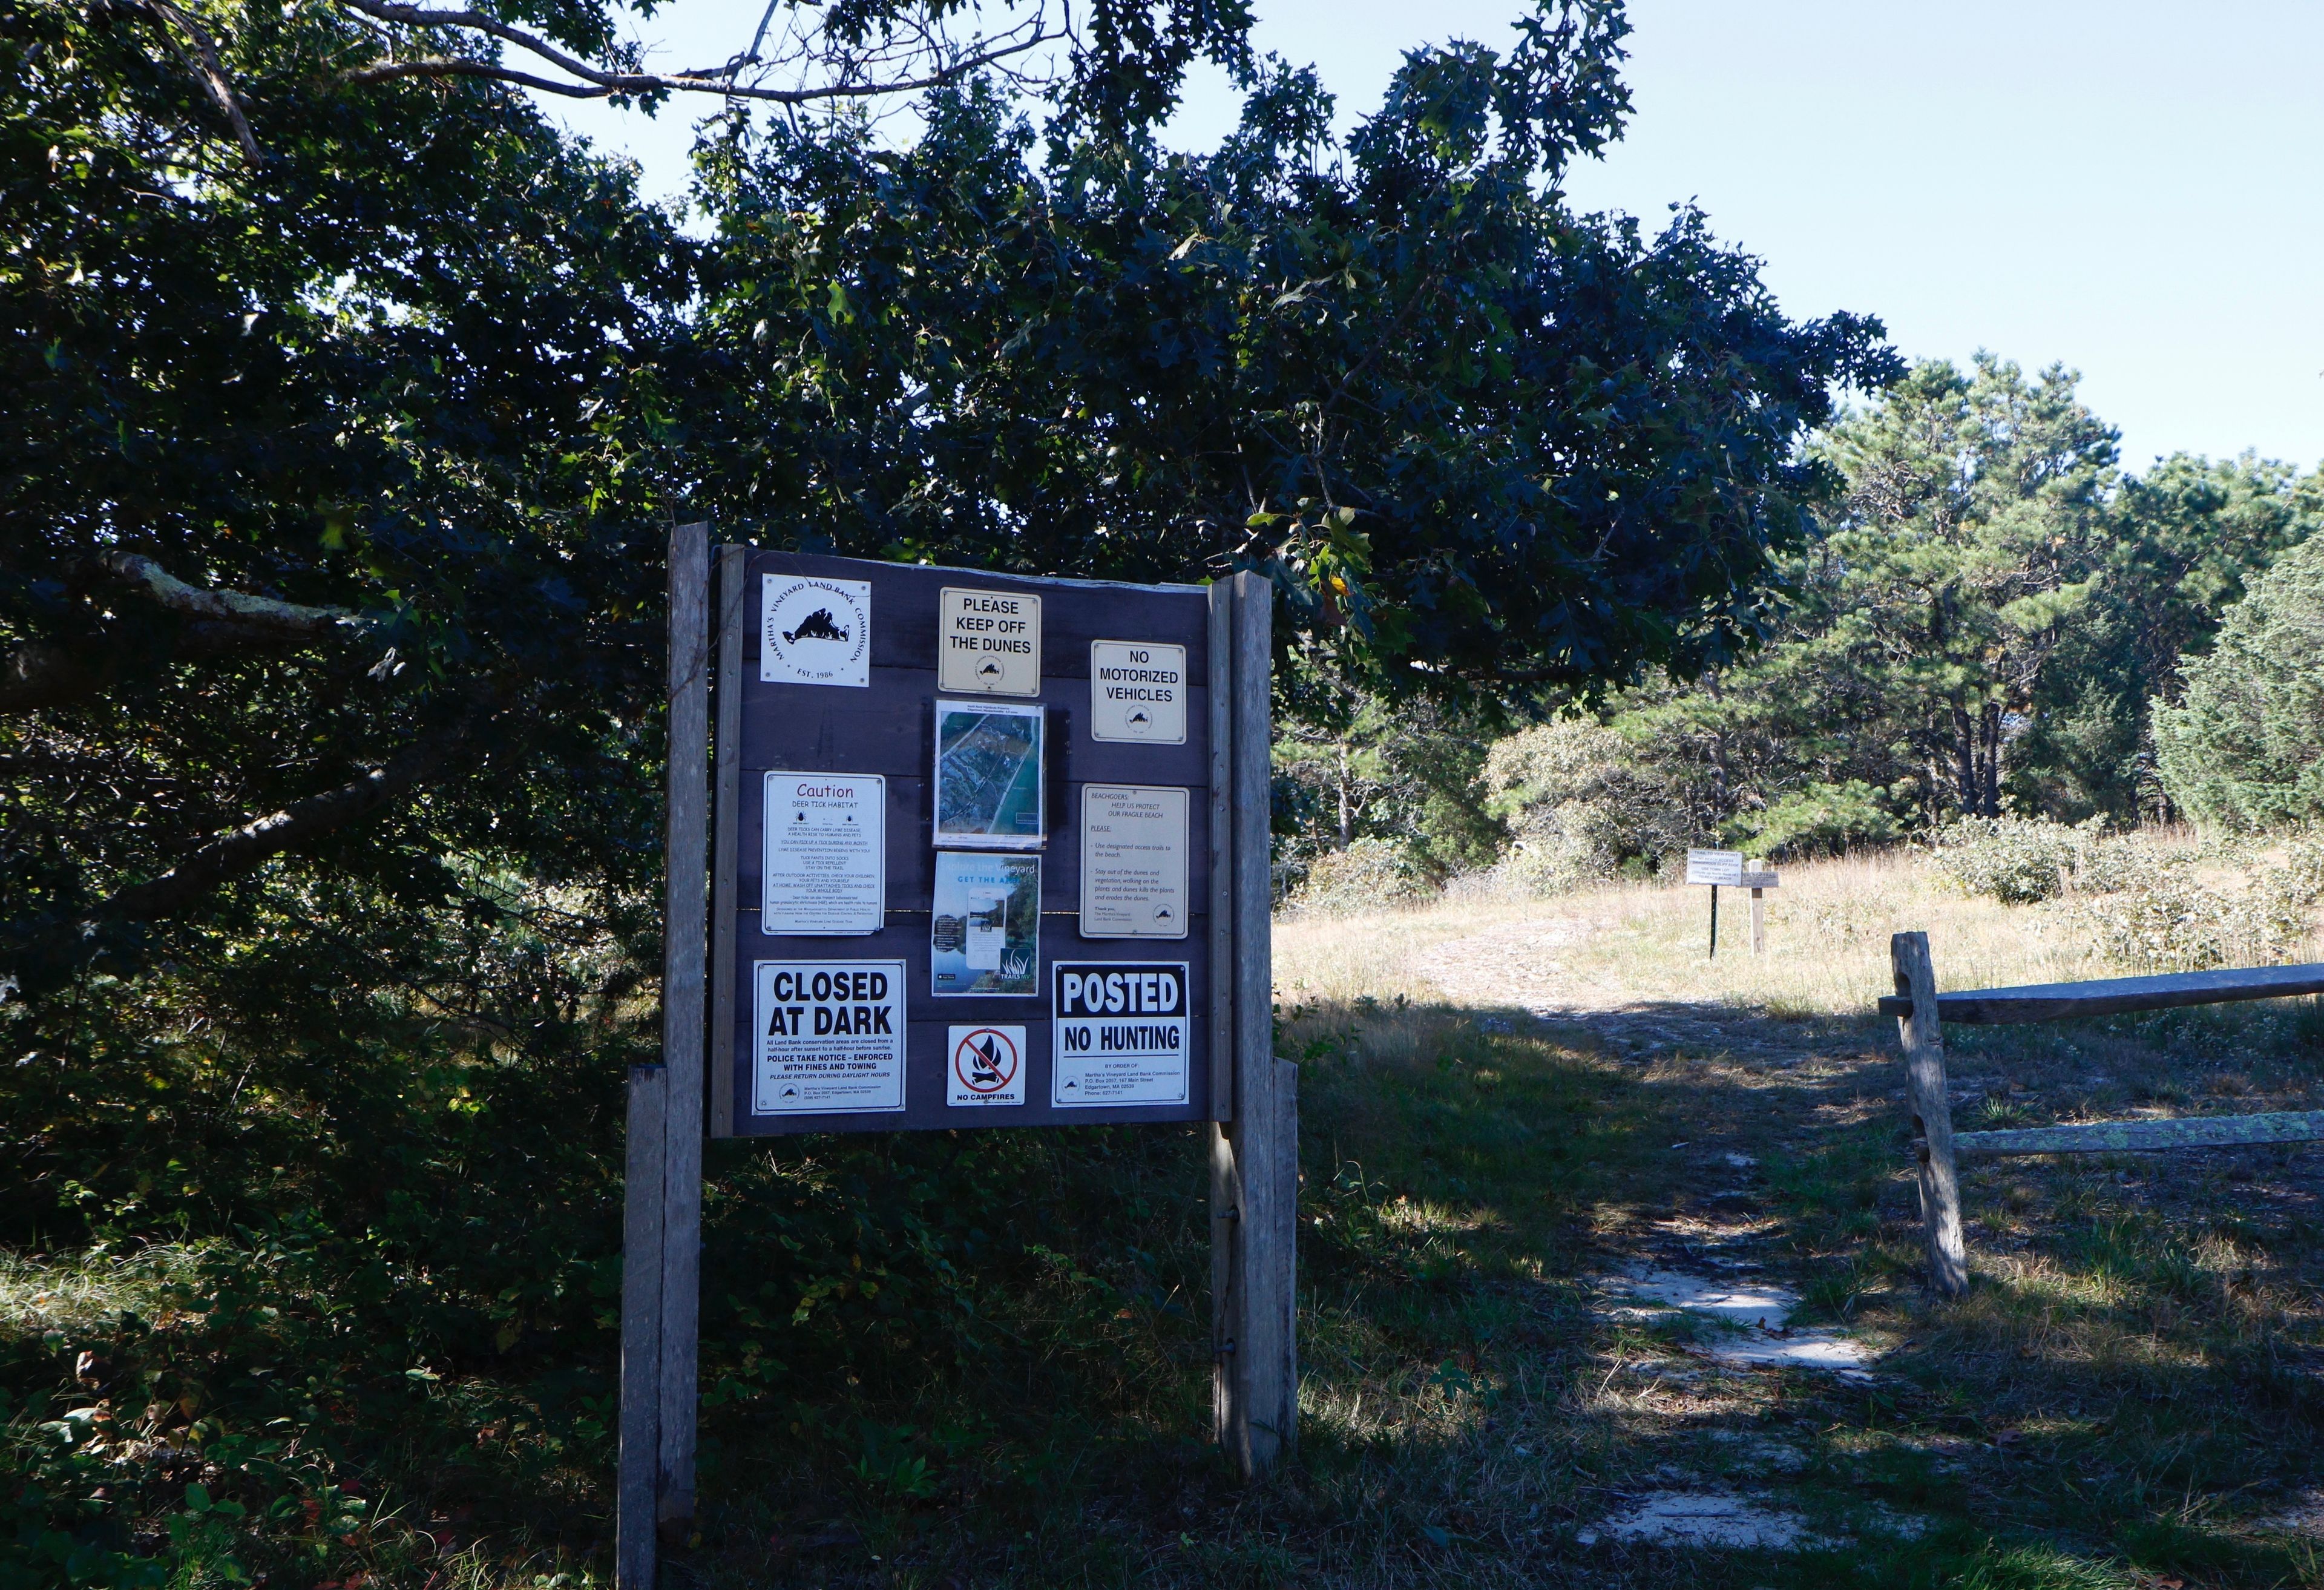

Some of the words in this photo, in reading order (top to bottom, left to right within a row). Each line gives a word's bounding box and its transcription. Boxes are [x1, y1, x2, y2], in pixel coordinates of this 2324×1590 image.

[809, 582, 832, 590] LAND
[771, 583, 804, 612] VINEYARD
[835, 586, 855, 605] BANK
[963, 598, 1019, 614] PLEASE
[956, 617, 994, 631] KEEP
[999, 620, 1026, 634] OFF
[767, 617, 784, 660] MARTHA'S
[850, 608, 866, 663] COMMISSION
[950, 636, 978, 650] THE
[983, 639, 1031, 654] DUNES
[1130, 651, 1149, 663] NO
[797, 668, 813, 678] EST.
[1100, 668, 1178, 683] MOTORIZED
[1106, 687, 1172, 701] VEHICLES
[797, 784, 853, 798] Caution
[941, 862, 975, 872] Explore
[978, 862, 993, 872] the
[996, 864, 1035, 875] Vineyard
[773, 971, 888, 1002] CLOSED
[1063, 973, 1178, 1013] POSTED
[768, 1007, 804, 1036] AT
[814, 1006, 893, 1036] DARK
[1065, 1027, 1091, 1051] NO
[1101, 1025, 1180, 1050] HUNTING
